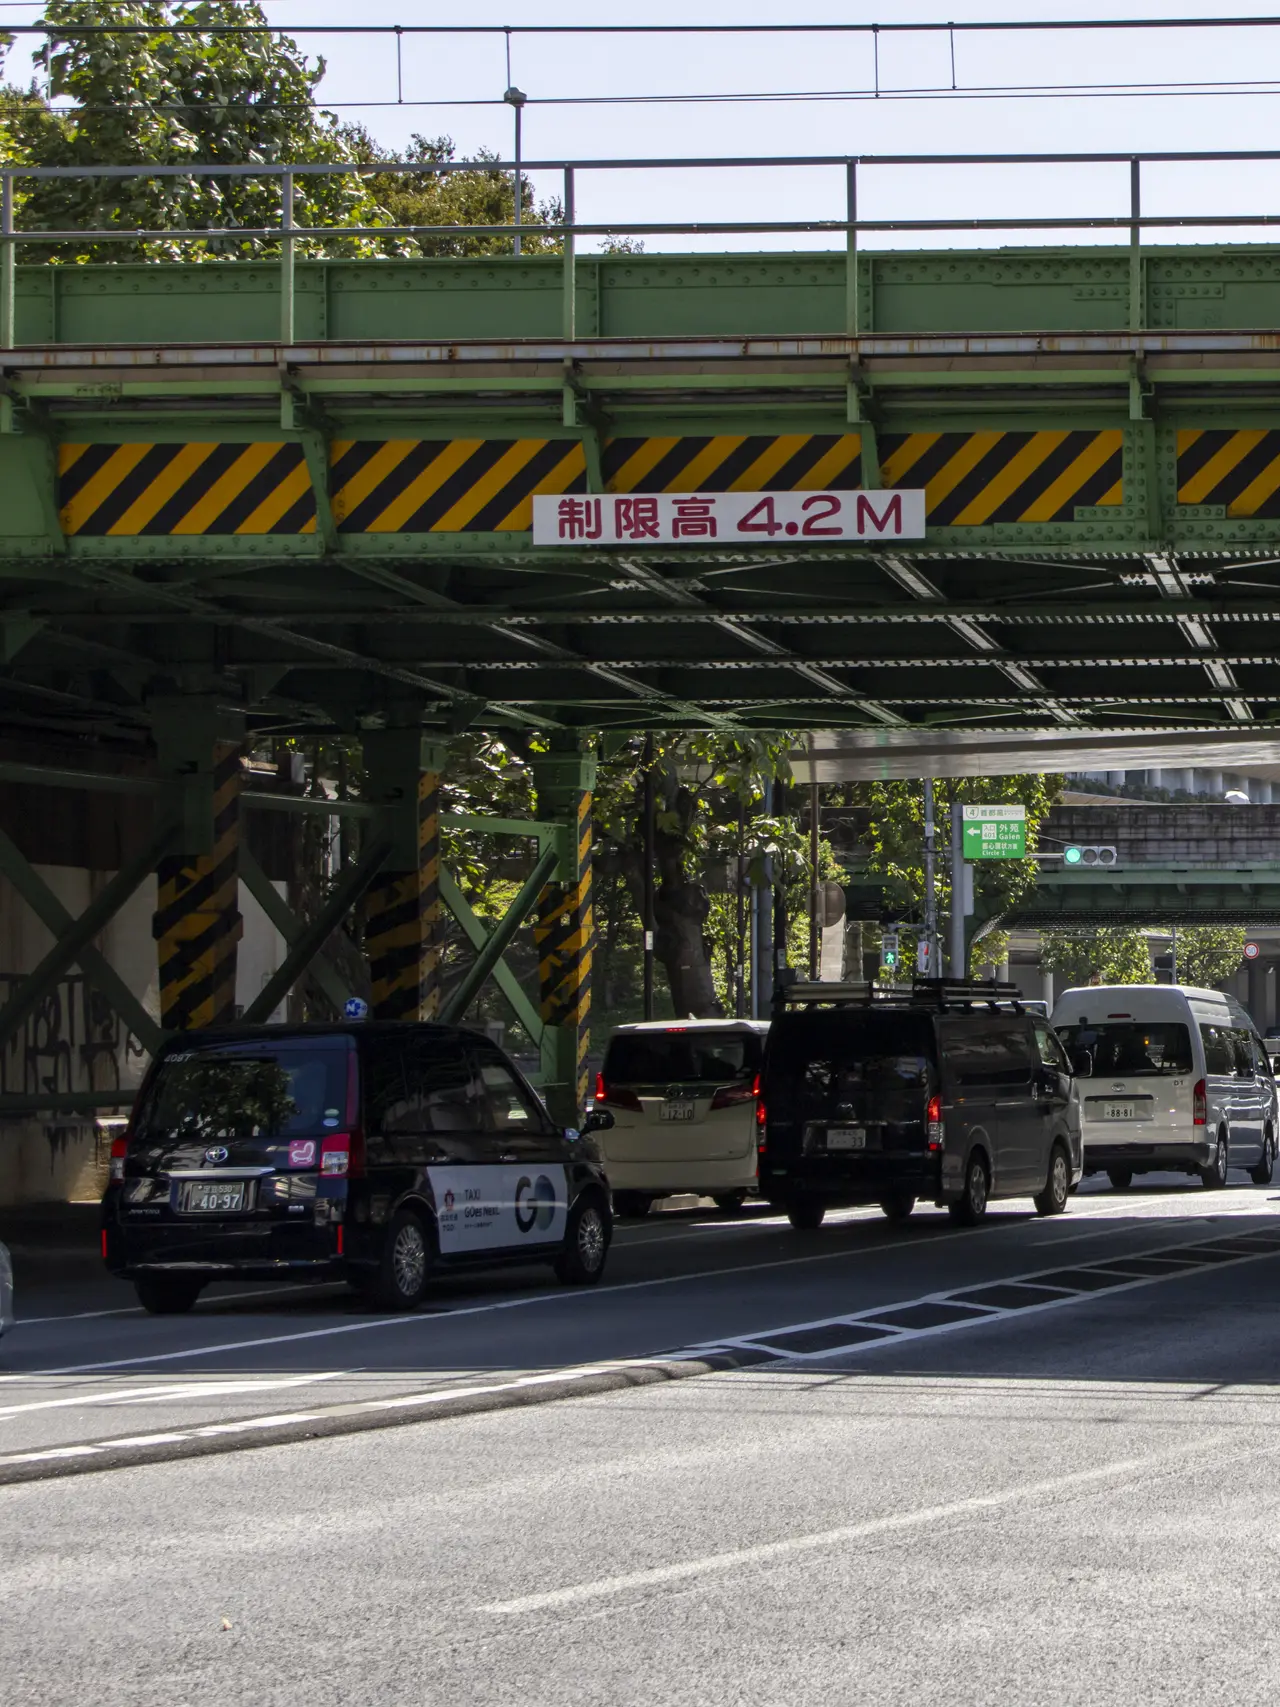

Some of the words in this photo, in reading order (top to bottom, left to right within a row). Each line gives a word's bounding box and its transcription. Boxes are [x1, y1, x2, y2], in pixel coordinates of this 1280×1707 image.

[999, 823, 1019, 833] 外苑
[164, 1053, 192, 1062] 4097
[1110, 1109, 1133, 1117] 88-81
[219, 1185, 233, 1193] 530
[464, 1188, 481, 1201] TAXI
[200, 1194, 240, 1209] 40-97
[515, 1175, 556, 1233] GO
